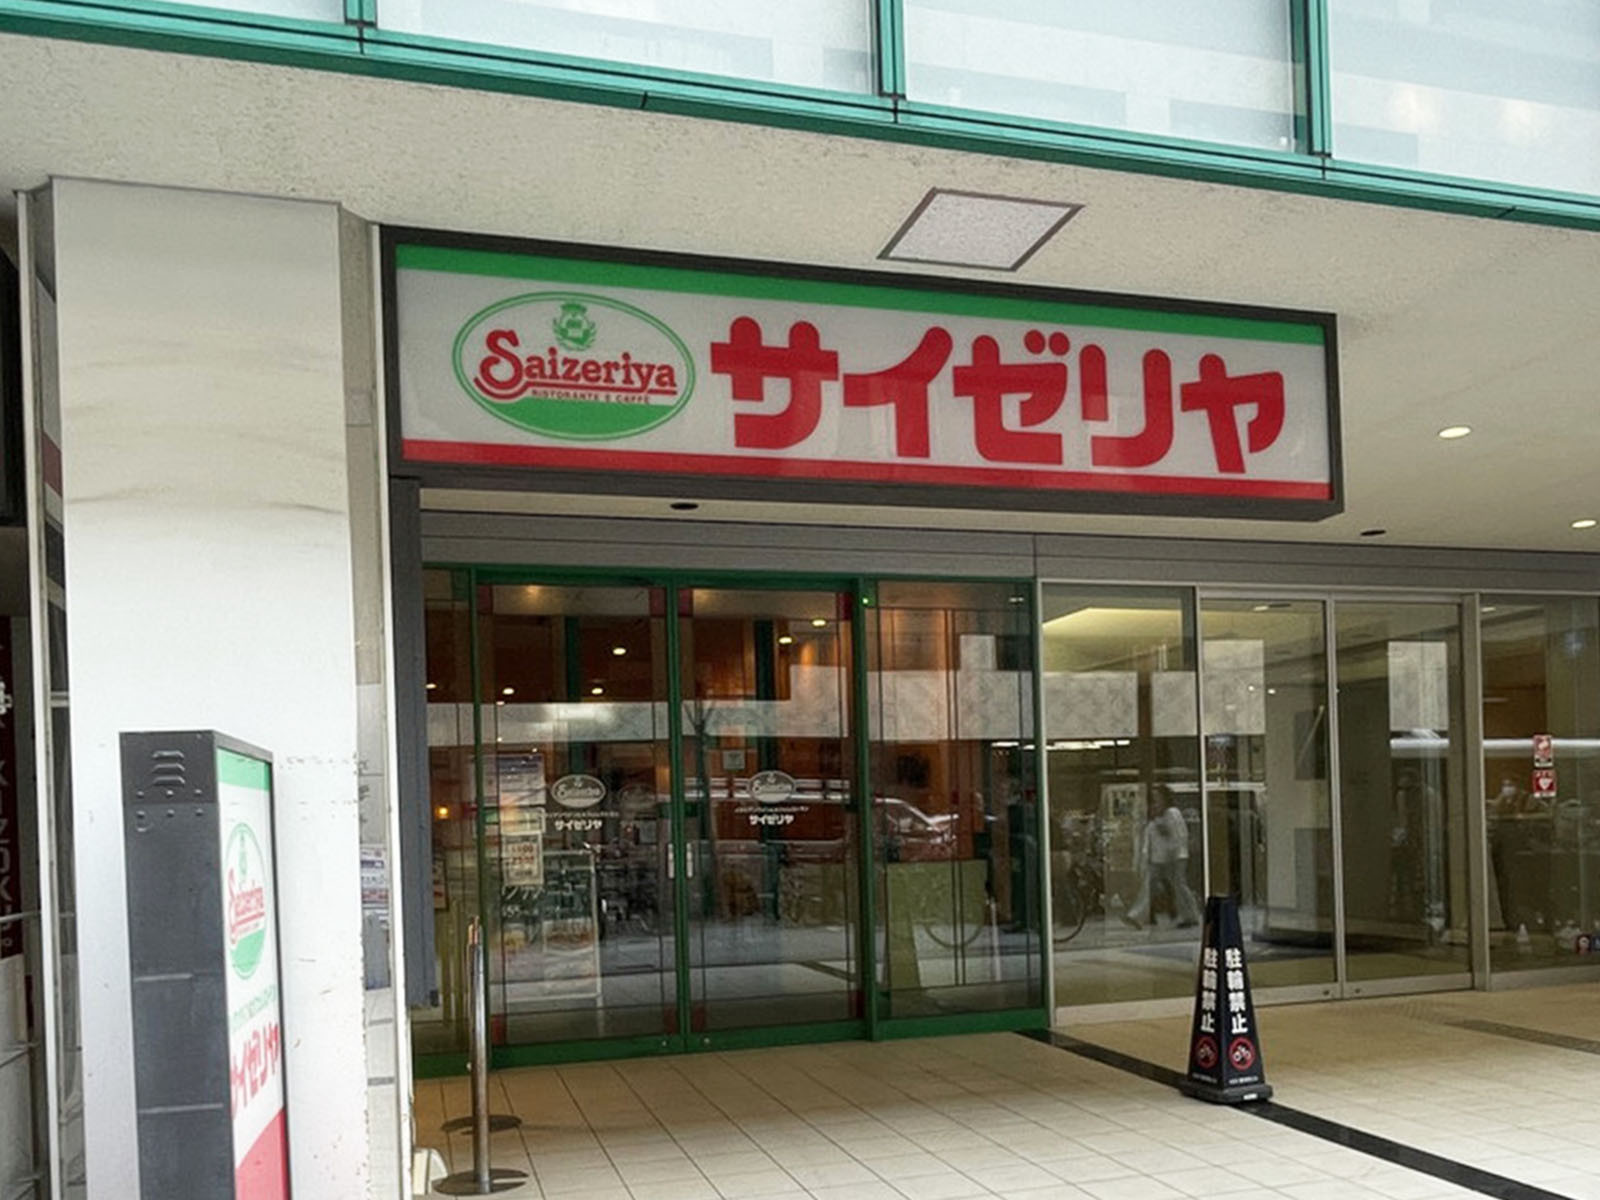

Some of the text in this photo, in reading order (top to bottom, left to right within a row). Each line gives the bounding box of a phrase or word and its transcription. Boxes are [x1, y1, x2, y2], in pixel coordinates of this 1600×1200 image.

[474, 329, 678, 400] Saizeriya
[531, 389, 599, 402] RISTORANTE
[710, 316, 1285, 474] サイゼリヤ
[554, 819, 603, 831] サイゼリヤ
[1225, 947, 1249, 1035] 駐輪禁止
